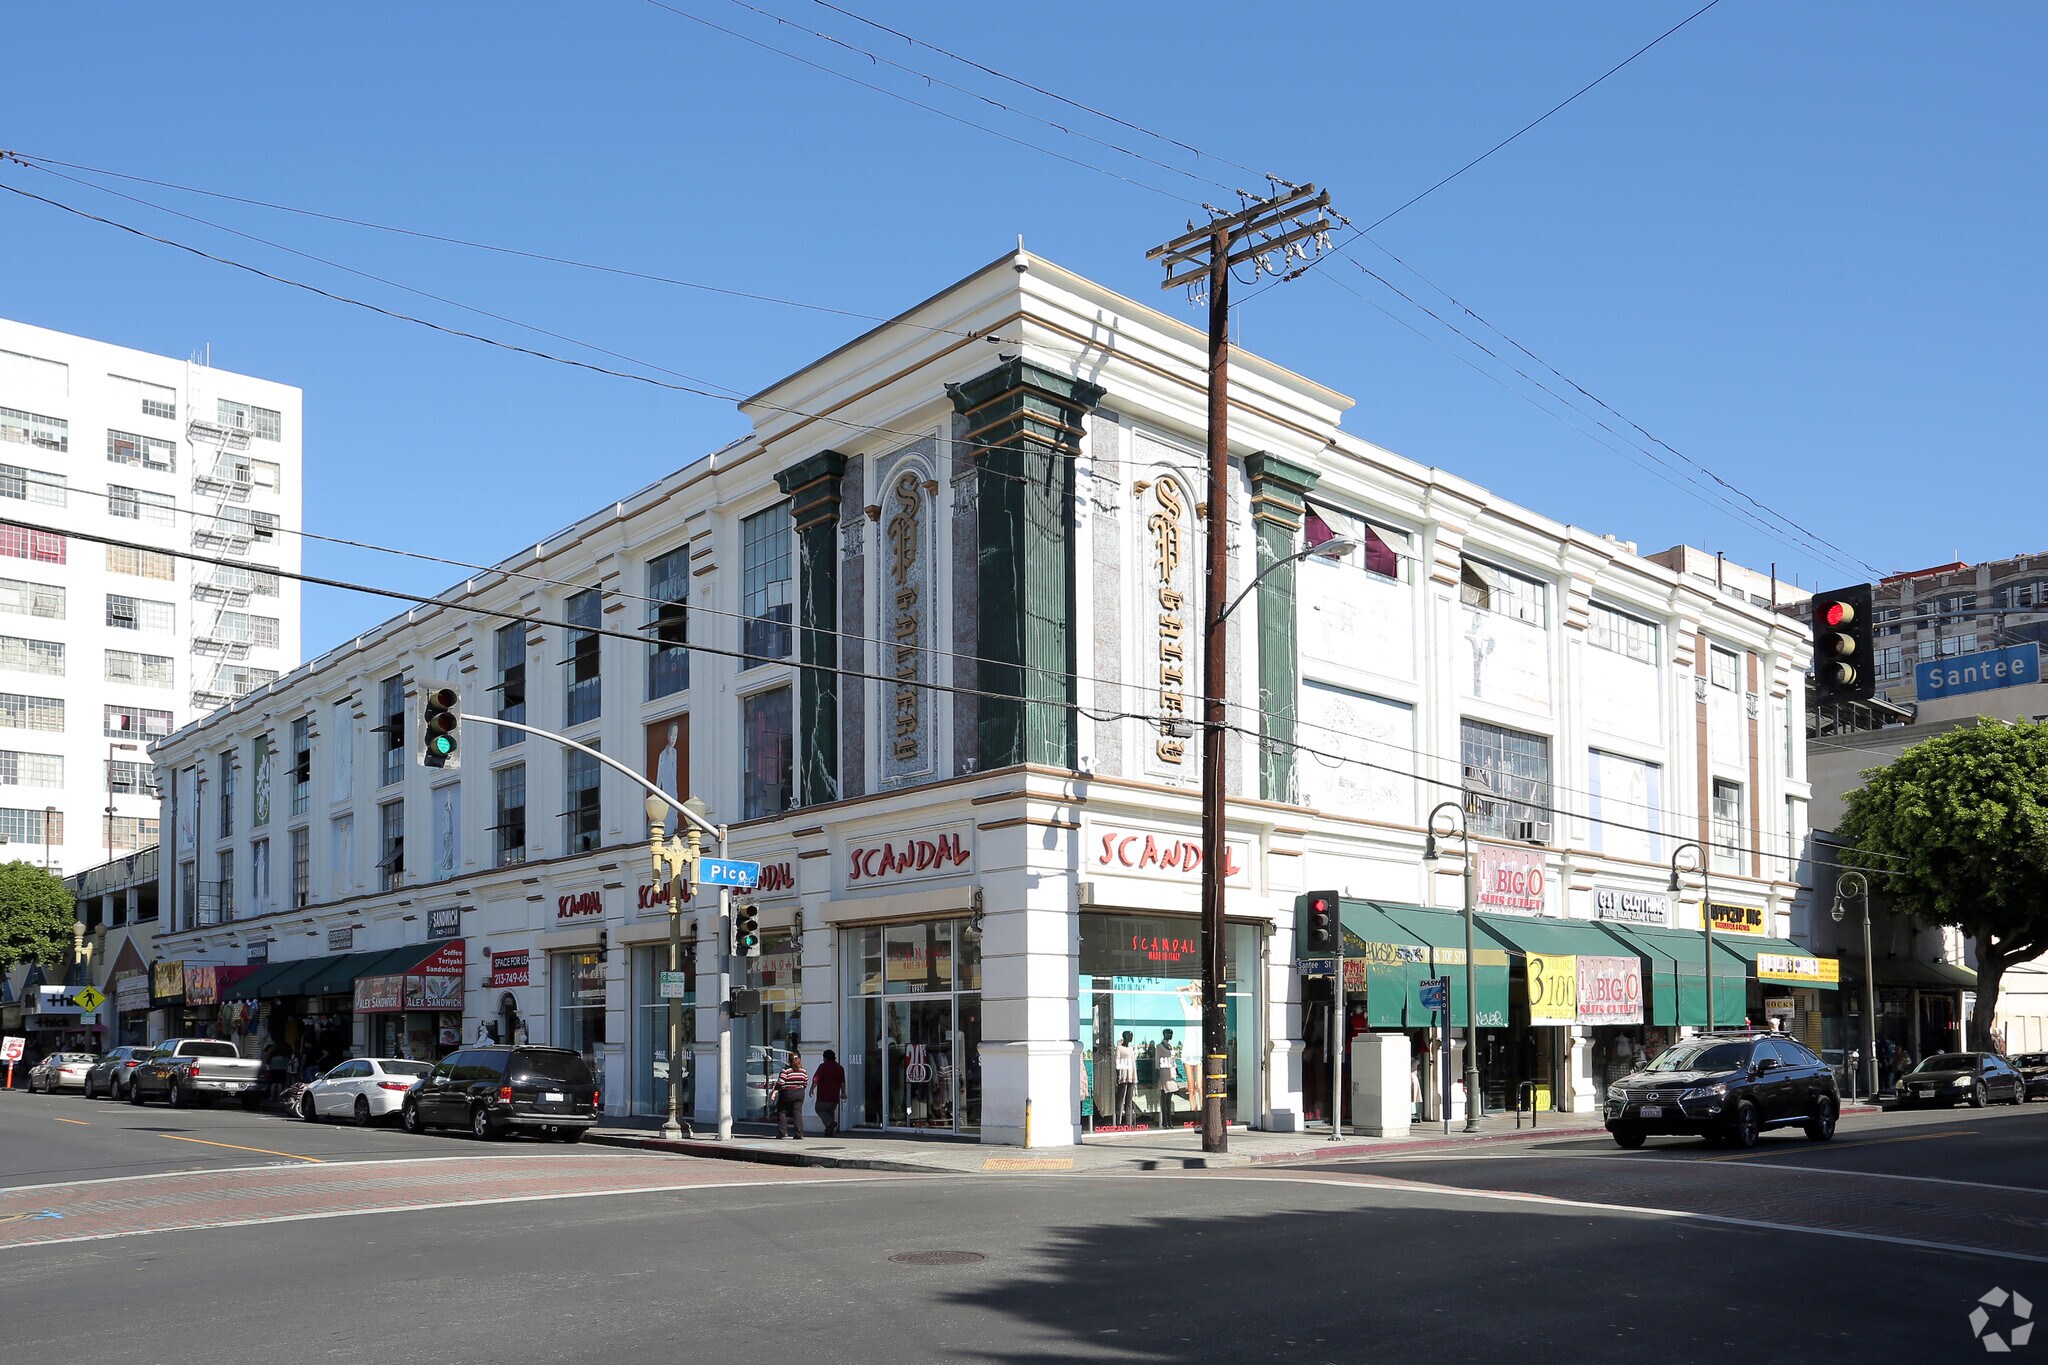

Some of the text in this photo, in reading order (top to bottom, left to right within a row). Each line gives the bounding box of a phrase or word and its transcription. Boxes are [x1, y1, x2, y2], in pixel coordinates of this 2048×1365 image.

[1929, 658, 2025, 689] Santee
[849, 833, 970, 880] SCANDAL
[1100, 833, 1241, 877] SCANDL
[711, 865, 746, 880] Pico
[733, 862, 795, 895] NDAL
[1497, 869, 1525, 894] BIG
[1528, 868, 1544, 897] O
[638, 879, 691, 909] SCANL
[1480, 894, 1542, 909] SUITS OUTLET
[557, 891, 603, 918] SCANDAL
[1621, 893, 1666, 915] CLOTHING
[433, 909, 459, 927] SANDWICH
[1746, 908, 1762, 926] INC
[1132, 935, 1196, 954] SCANDAL
[438, 957, 462, 966] Teriyaki
[494, 957, 510, 968] SPACE
[510, 956, 520, 967] FOR
[1298, 960, 1332, 969] Santee St
[1441, 949, 1454, 962] TOP
[1529, 958, 1544, 1006] 3
[1596, 979, 1622, 1001] BIG
[1626, 974, 1639, 1000] O
[359, 996, 397, 1008] ALEX SANDWICH
[407, 997, 461, 1007] ALEX SANDWICH
[1580, 1004, 1637, 1015] SUITS OUTLET
[1766, 1000, 1794, 1008] SOCKS
[681, 1050, 692, 1060] SALE
[848, 1054, 862, 1065] SALE
